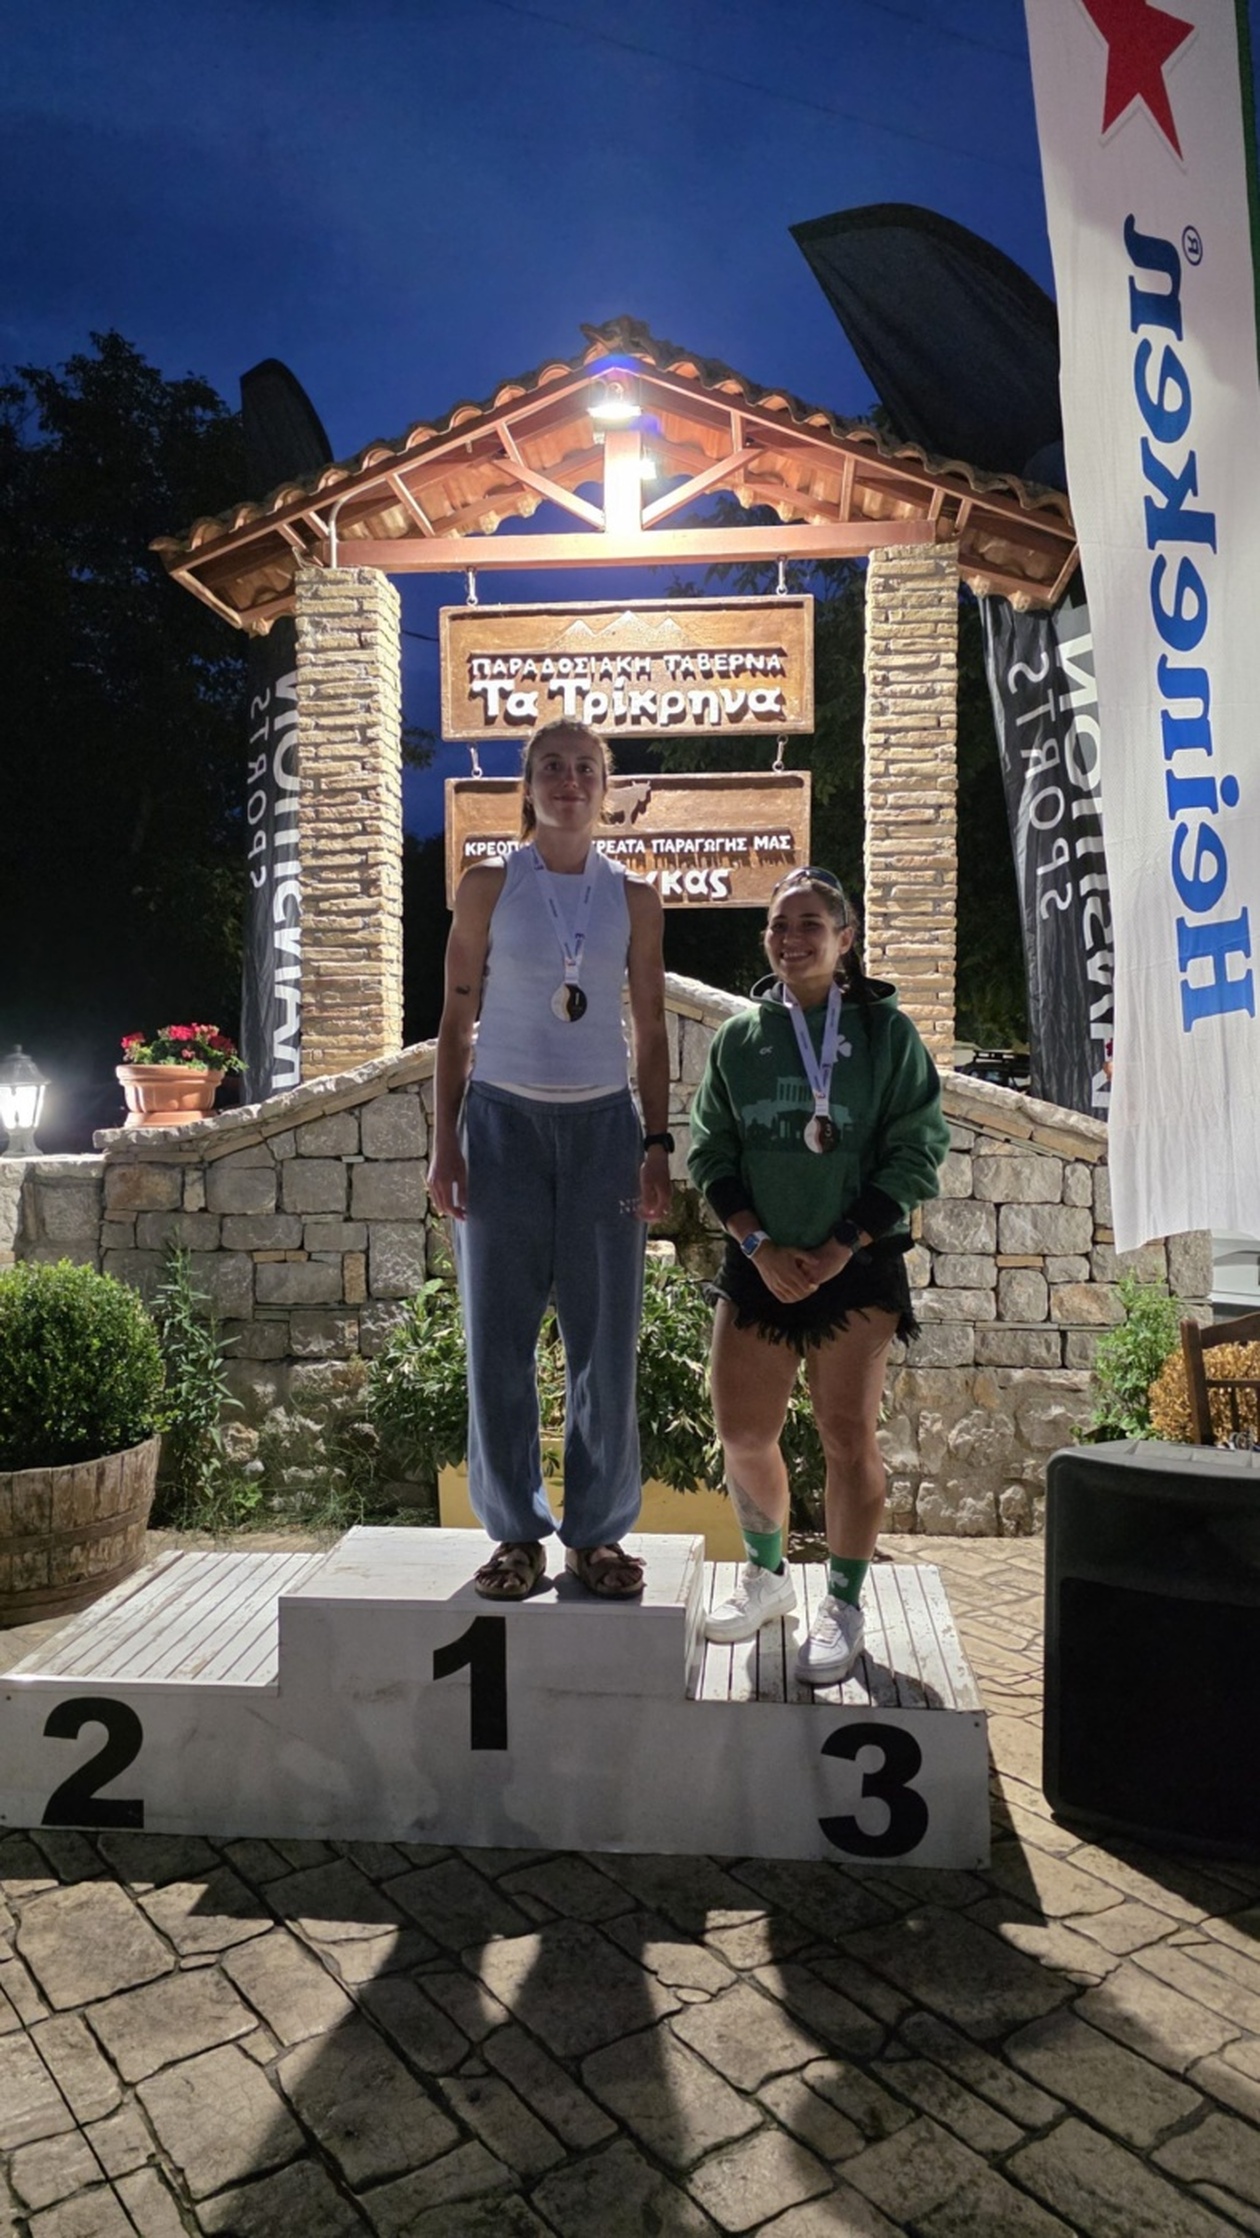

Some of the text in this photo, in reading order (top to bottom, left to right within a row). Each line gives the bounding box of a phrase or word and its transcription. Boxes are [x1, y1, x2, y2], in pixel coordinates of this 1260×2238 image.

[472, 653, 781, 676] ΠΑΡΑΔΟΣΙΑΚΗ ΤΑΒΕΡΝΑ
[472, 676, 781, 725] Τα Τρίκρηνα
[464, 835, 791, 857] ΚΡΕΟΠ ΡΕΑΤΑ ΠΑΡΑΓΩΓΗΣ ΜΑΣ
[432, 1615, 509, 1751] 1
[41, 1696, 145, 1829] 2
[817, 1721, 930, 1859] 3
